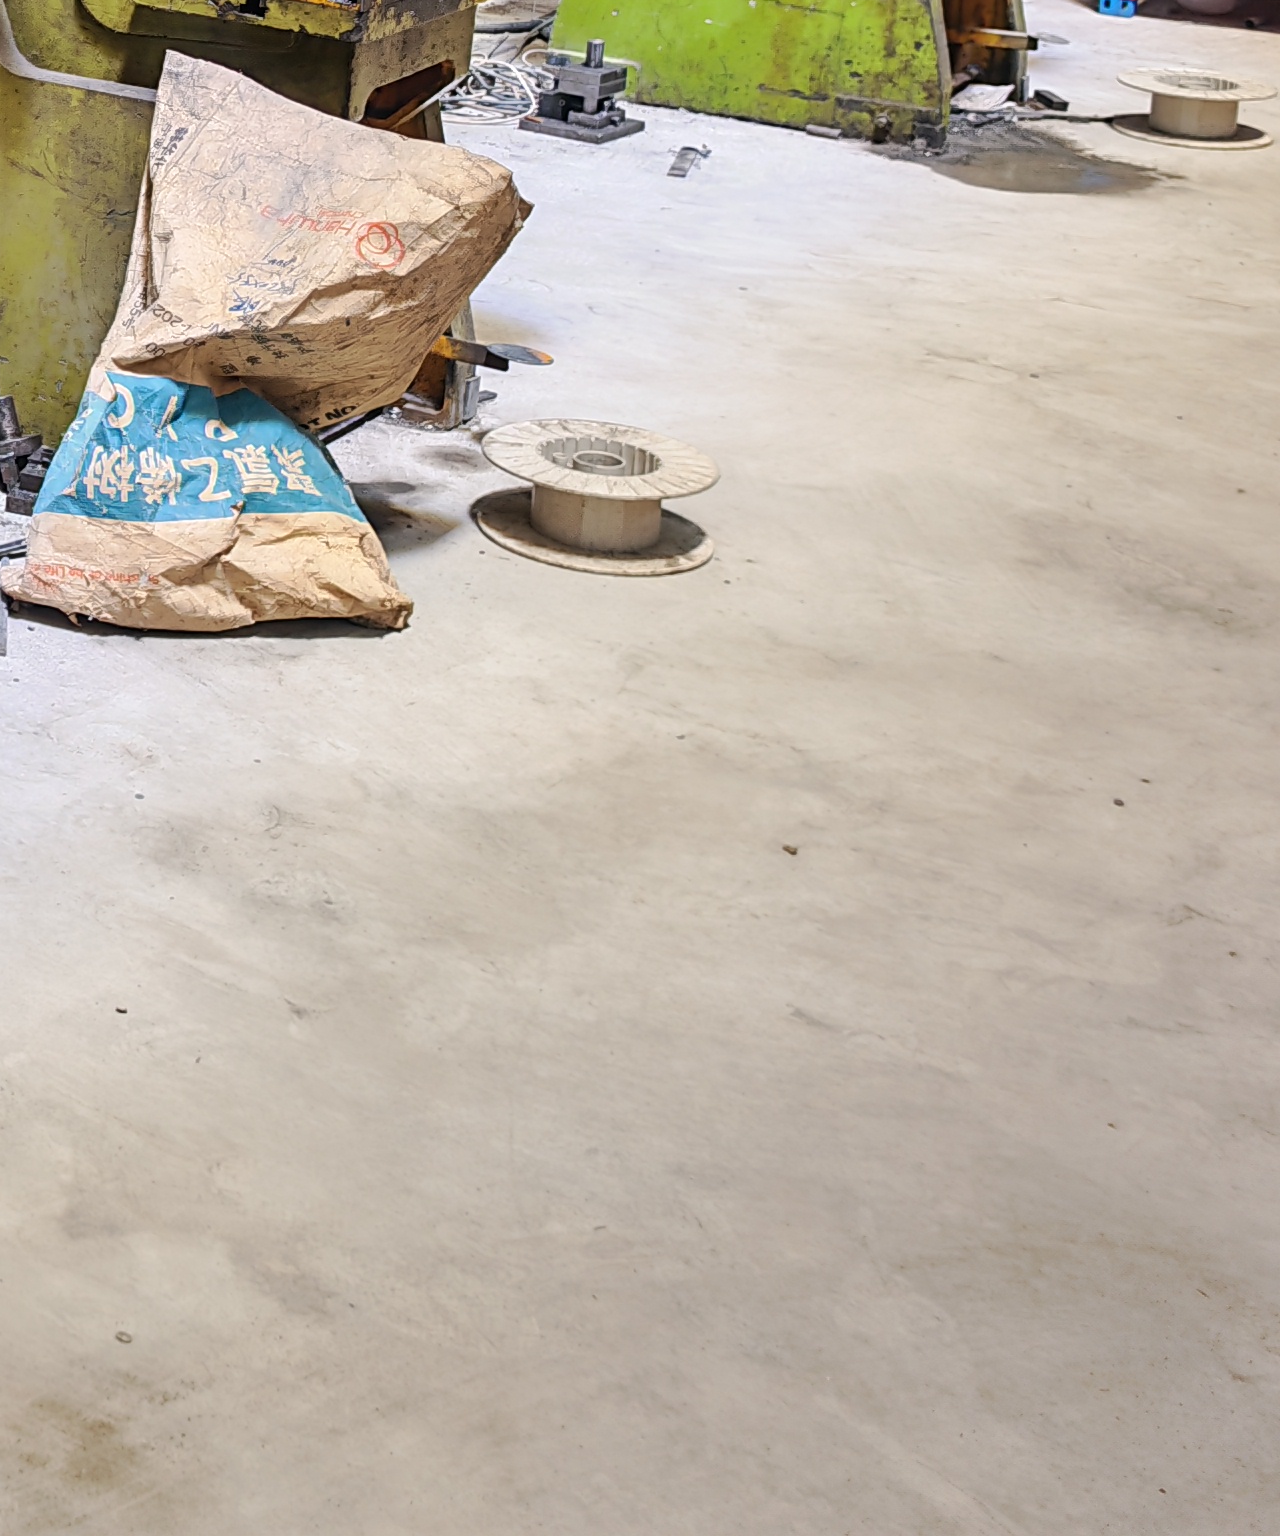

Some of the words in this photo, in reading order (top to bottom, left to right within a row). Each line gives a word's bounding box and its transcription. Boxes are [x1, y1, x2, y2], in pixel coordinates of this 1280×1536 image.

[64, 443, 323, 507] 聚氯乙烯树
